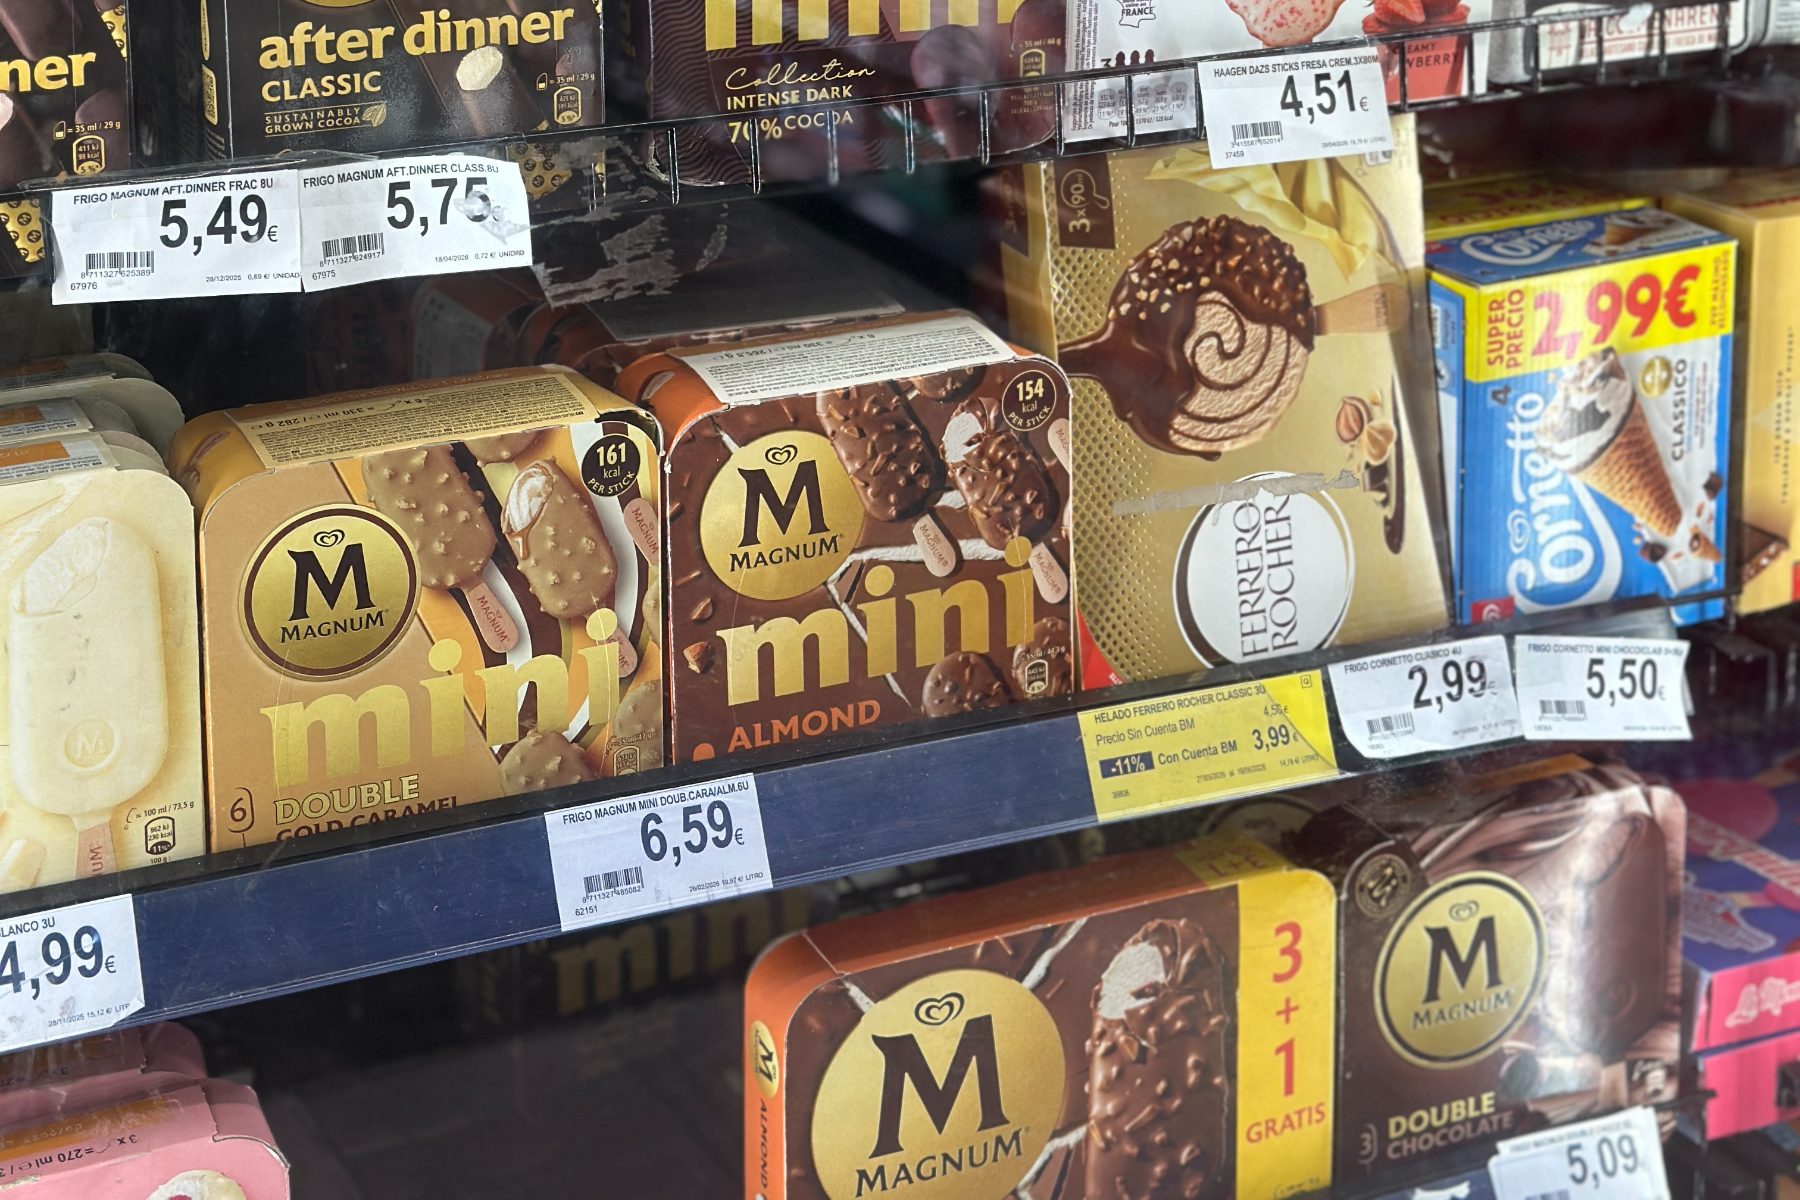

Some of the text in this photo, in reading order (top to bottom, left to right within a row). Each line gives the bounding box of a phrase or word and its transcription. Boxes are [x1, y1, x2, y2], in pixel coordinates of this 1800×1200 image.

[1122, 6, 1154, 17] FRANCE
[258, 8, 575, 70] after dinner
[261, 71, 382, 102] CLASSIC
[725, 59, 875, 90] Collection
[1214, 66, 1247, 77] HAAGEN
[1249, 65, 1270, 75] DAZS
[1272, 63, 1300, 72] STICKS
[1302, 61, 1327, 71] FRESA
[265, 106, 361, 125] SUSTAINABLY
[727, 85, 853, 110] INTENSE DARK
[265, 116, 361, 134] GROWN COCOA
[73, 178, 273, 205] FRIGO MAGNUM AFT.DINNER FRAC 8U
[303, 176, 335, 188] FRIGO
[337, 168, 384, 183] MAGNUM
[386, 165, 448, 178] AFT.DINNER
[70, 281, 98, 290] 67976
[312, 269, 336, 280] 67975
[1505, 289, 1525, 370] PRECIO
[1530, 264, 1701, 360] 2,99€
[1487, 298, 1506, 367] SUPER
[1016, 377, 1045, 402] 154
[1021, 402, 1038, 413] kcal
[1007, 406, 1050, 429] PER STICK
[1671, 358, 1688, 462] CLASSICO
[597, 442, 626, 467] 161
[604, 466, 621, 479] kcal
[588, 471, 635, 494] PER STICK
[737, 460, 830, 548] M
[1506, 392, 1623, 615] Cornetto
[632, 507, 659, 554] MAGNUM
[729, 534, 840, 572] MAGNUM
[287, 548, 376, 622] M
[1233, 502, 1270, 658] FERRERO
[1264, 494, 1299, 651] ROCHER
[279, 611, 386, 645] MAGNUM
[476, 595, 508, 643] MAGNUM
[715, 536, 1035, 706] mini
[1344, 660, 1369, 673] FRIGO
[1370, 654, 1414, 668] CORNETTO
[1415, 649, 1450, 661] CLASICO
[259, 606, 623, 789] mini
[1094, 708, 1132, 724] HELADO
[1133, 700, 1175, 717] FERRERO
[1178, 694, 1214, 709] ROCHER
[1216, 688, 1253, 702] CLASSIC
[728, 699, 882, 753] ALMOND
[1095, 719, 1195, 746] Precio Sin Cuenta BM
[1110, 755, 1146, 773] -11%
[1158, 753, 1179, 765] Con
[1183, 746, 1218, 760] Cuenta
[1221, 740, 1238, 754] BM
[143, 802, 187, 818] 100 73,5
[230, 797, 247, 823] 6
[273, 773, 420, 826] DOUBLE
[563, 810, 592, 825] FRIGO
[594, 802, 637, 819] MAGNUM
[639, 798, 658, 810] MINI
[0, 917, 55, 938] LANCO 3U
[575, 906, 598, 916] 62151
[1272, 921, 1303, 984] 3
[1422, 916, 1502, 1005] M
[1412, 990, 1512, 1030] MAGNUM
[1274, 1037, 1295, 1097] 1
[868, 1014, 1011, 1159] M
[1245, 1102, 1327, 1145] GRATIS
[1388, 1091, 1496, 1139] DOUBLE
[1386, 1110, 1514, 1160] CHOCOLATE
[855, 1127, 1023, 1199] MAGNUM
